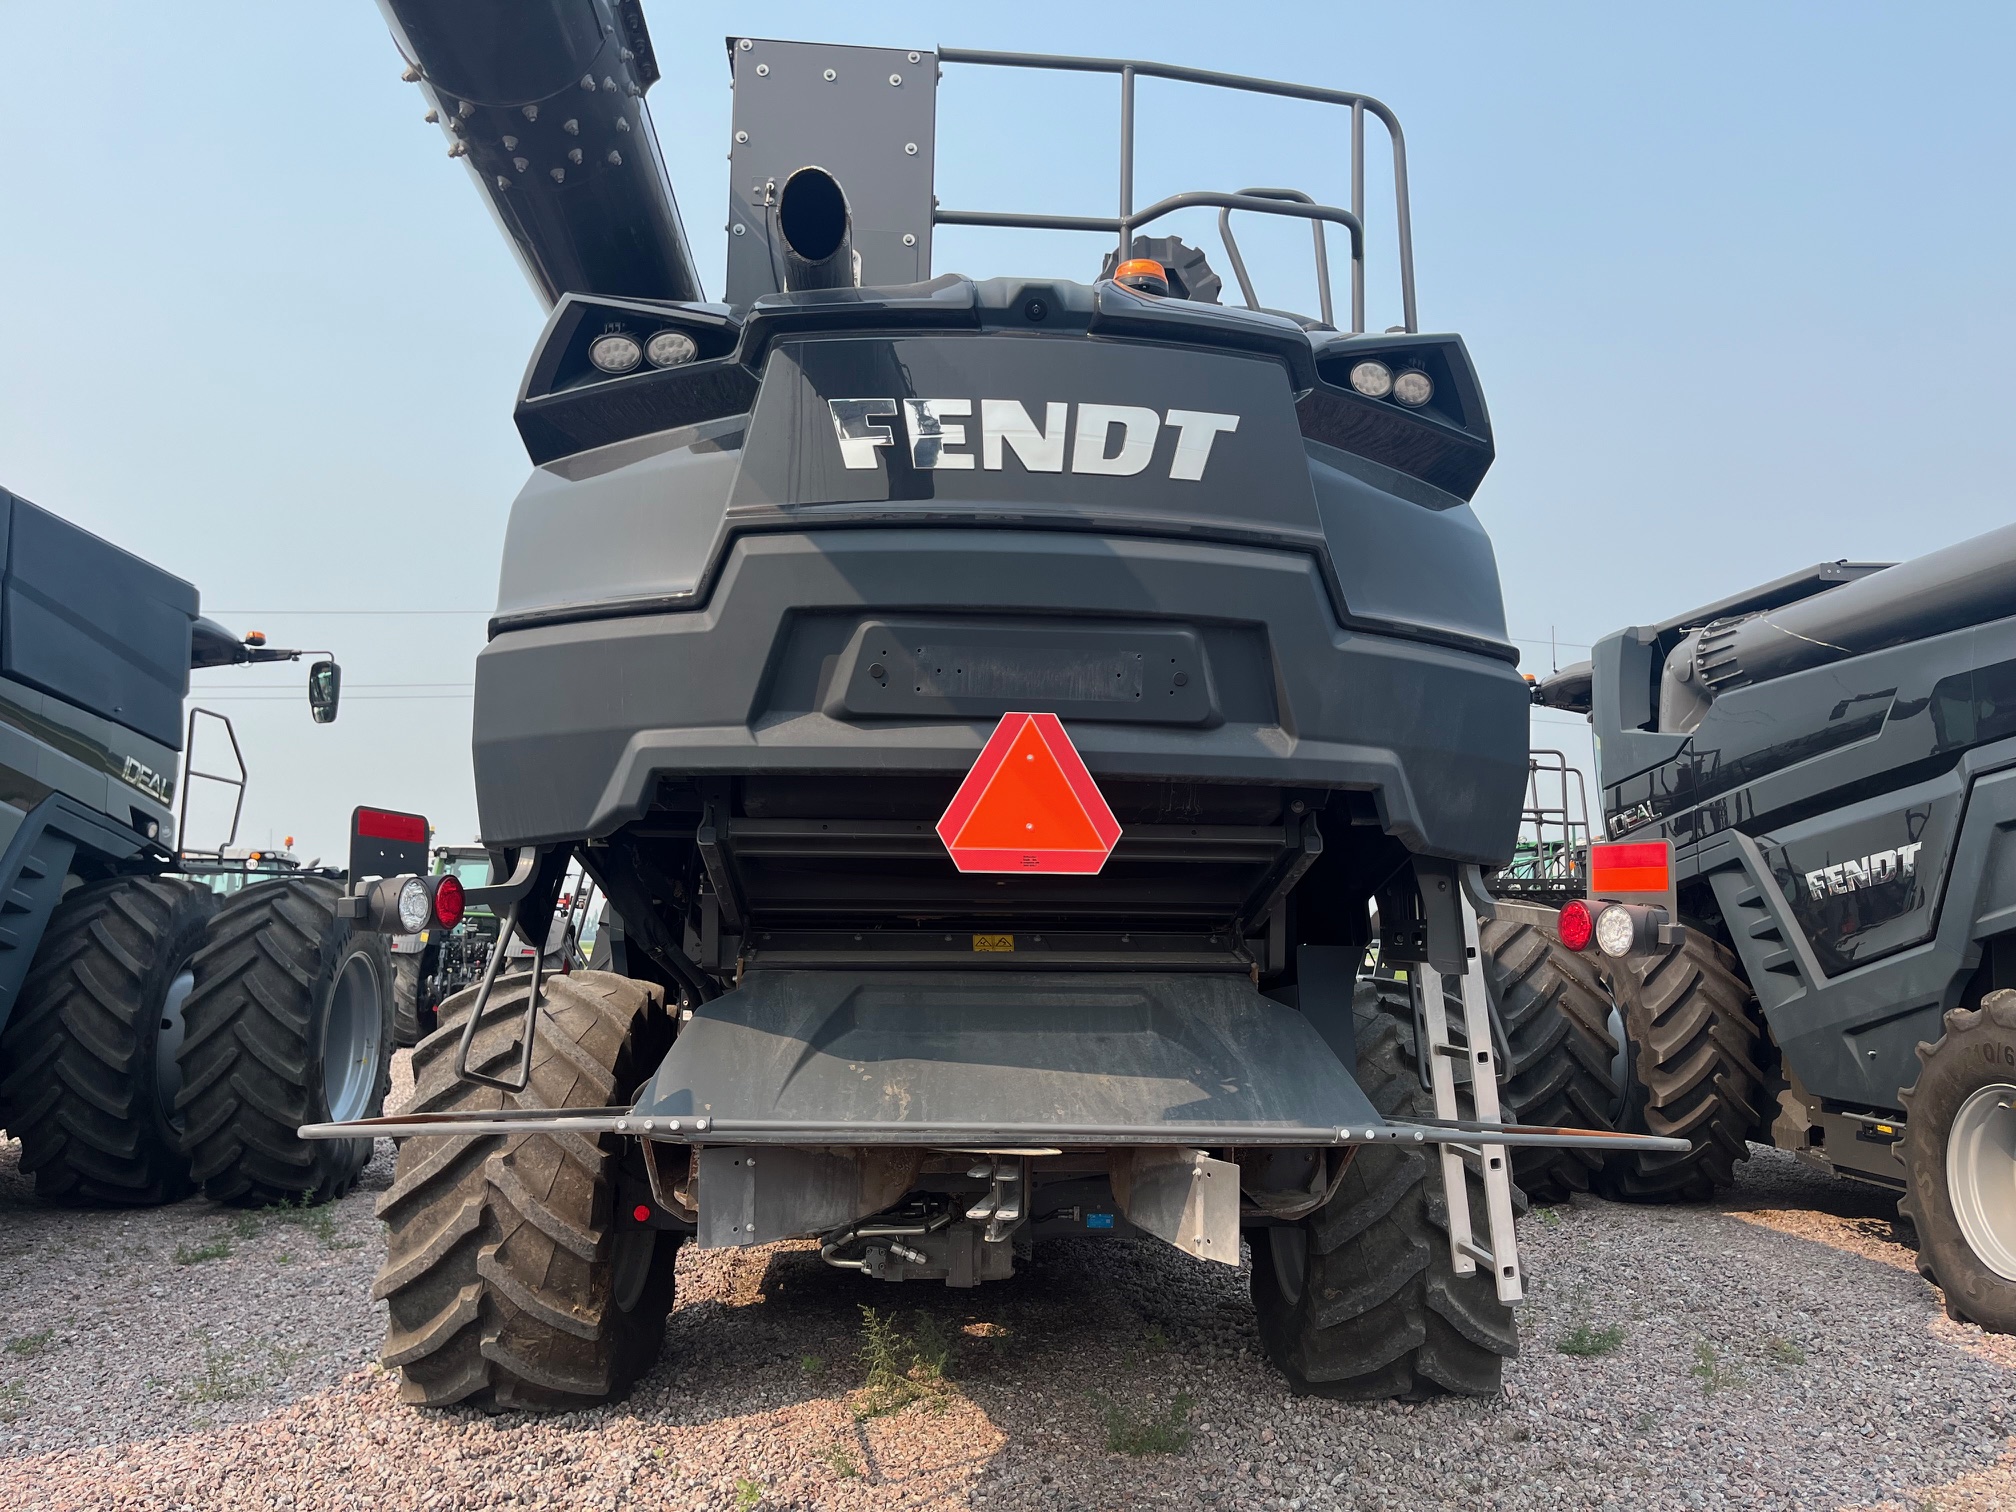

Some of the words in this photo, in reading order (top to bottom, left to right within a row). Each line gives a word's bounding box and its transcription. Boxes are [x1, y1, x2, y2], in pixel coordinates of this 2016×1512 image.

[827, 398, 1241, 481] FENDT
[121, 754, 171, 805] IDEAL
[1609, 799, 1663, 839] IDEAL
[1804, 840, 1923, 902] FENDT
